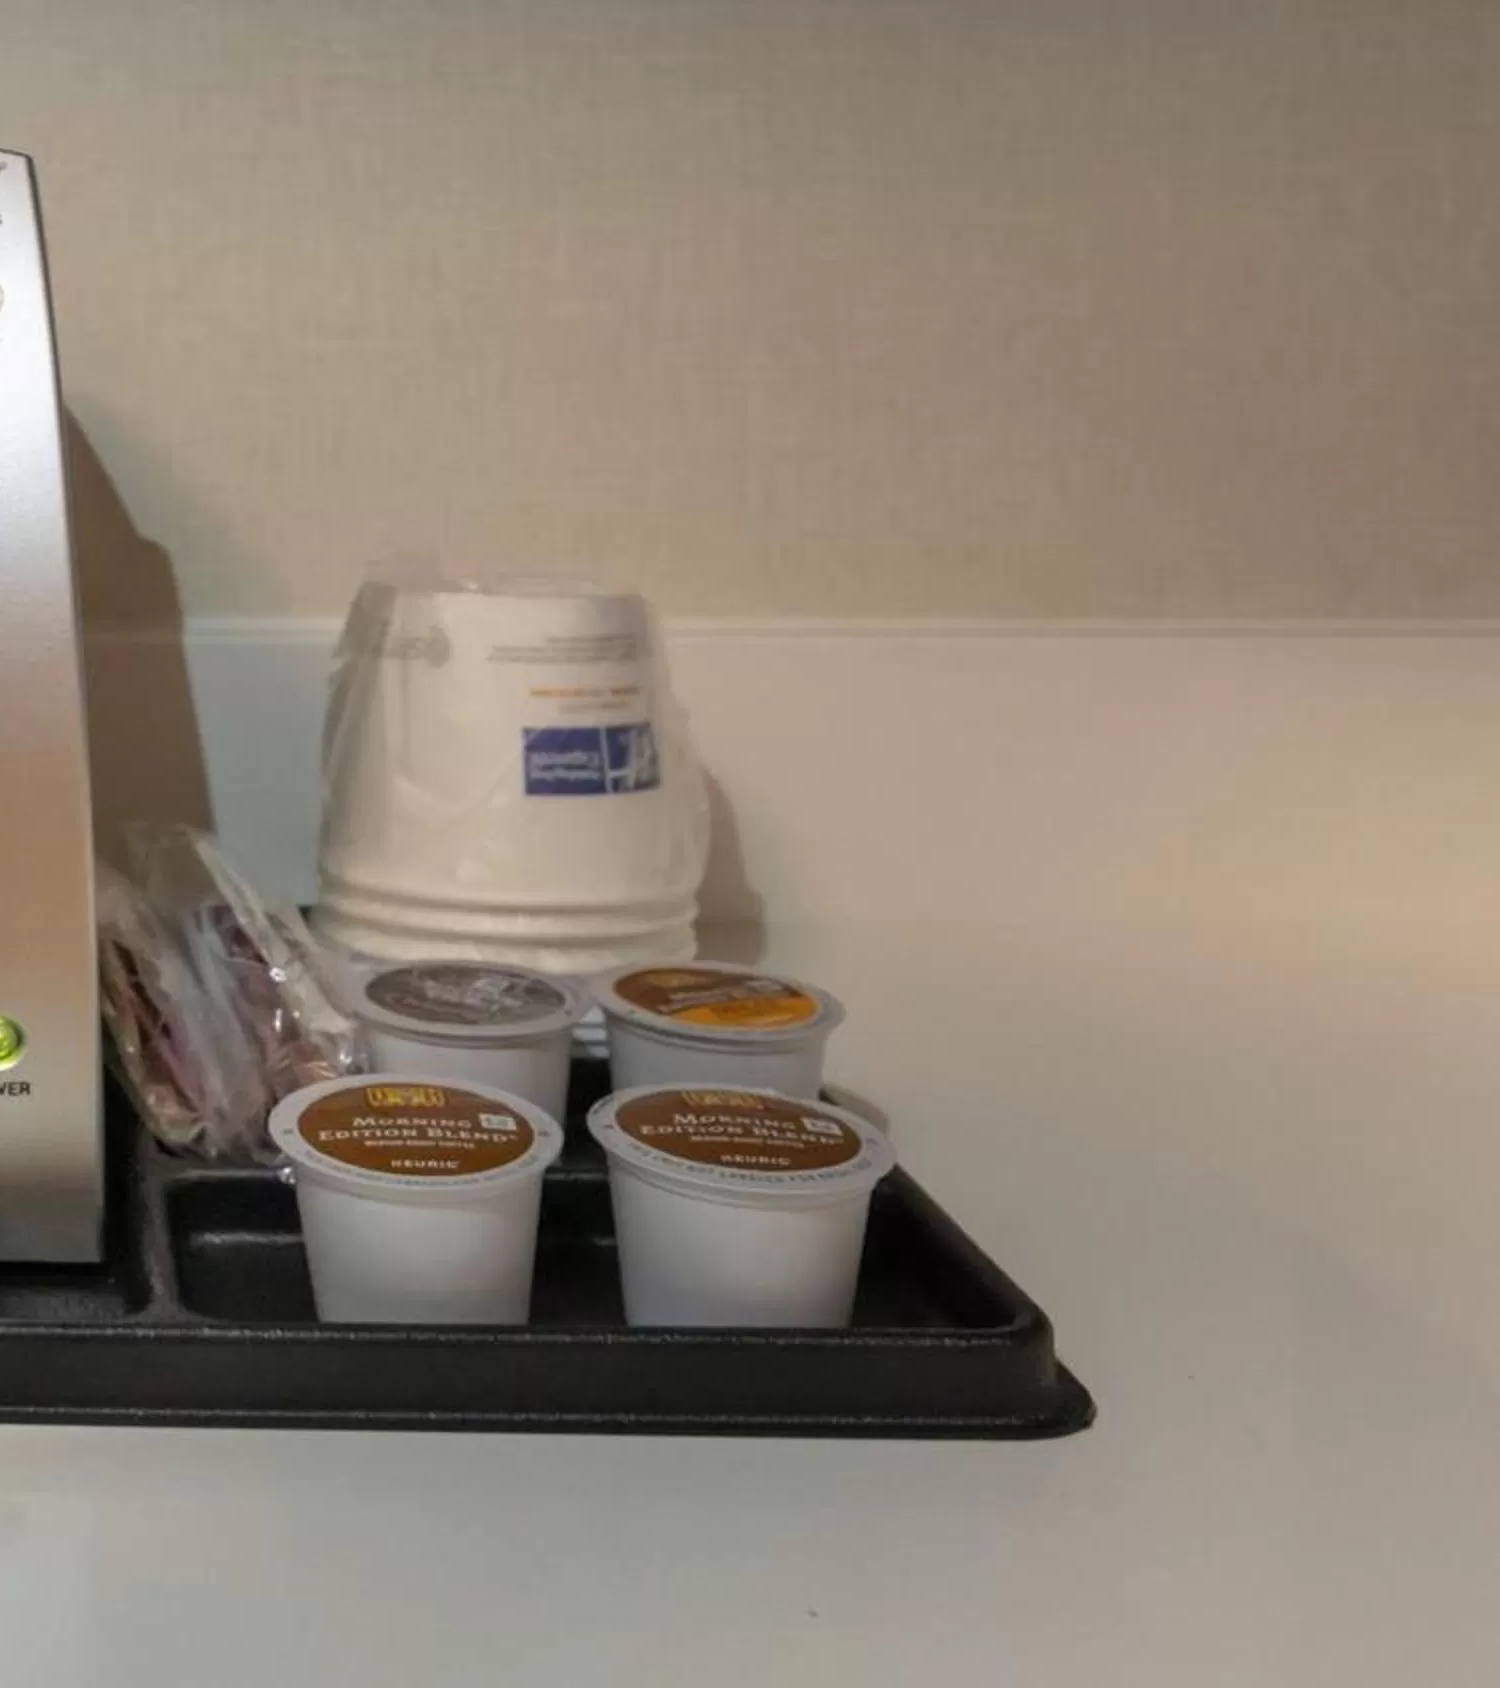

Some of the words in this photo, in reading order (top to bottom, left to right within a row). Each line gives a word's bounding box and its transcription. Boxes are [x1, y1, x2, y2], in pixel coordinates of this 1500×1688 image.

[352, 1116, 473, 1129] MORNING
[318, 1128, 418, 1142] EDITION
[390, 1158, 461, 1170] KEURIG
